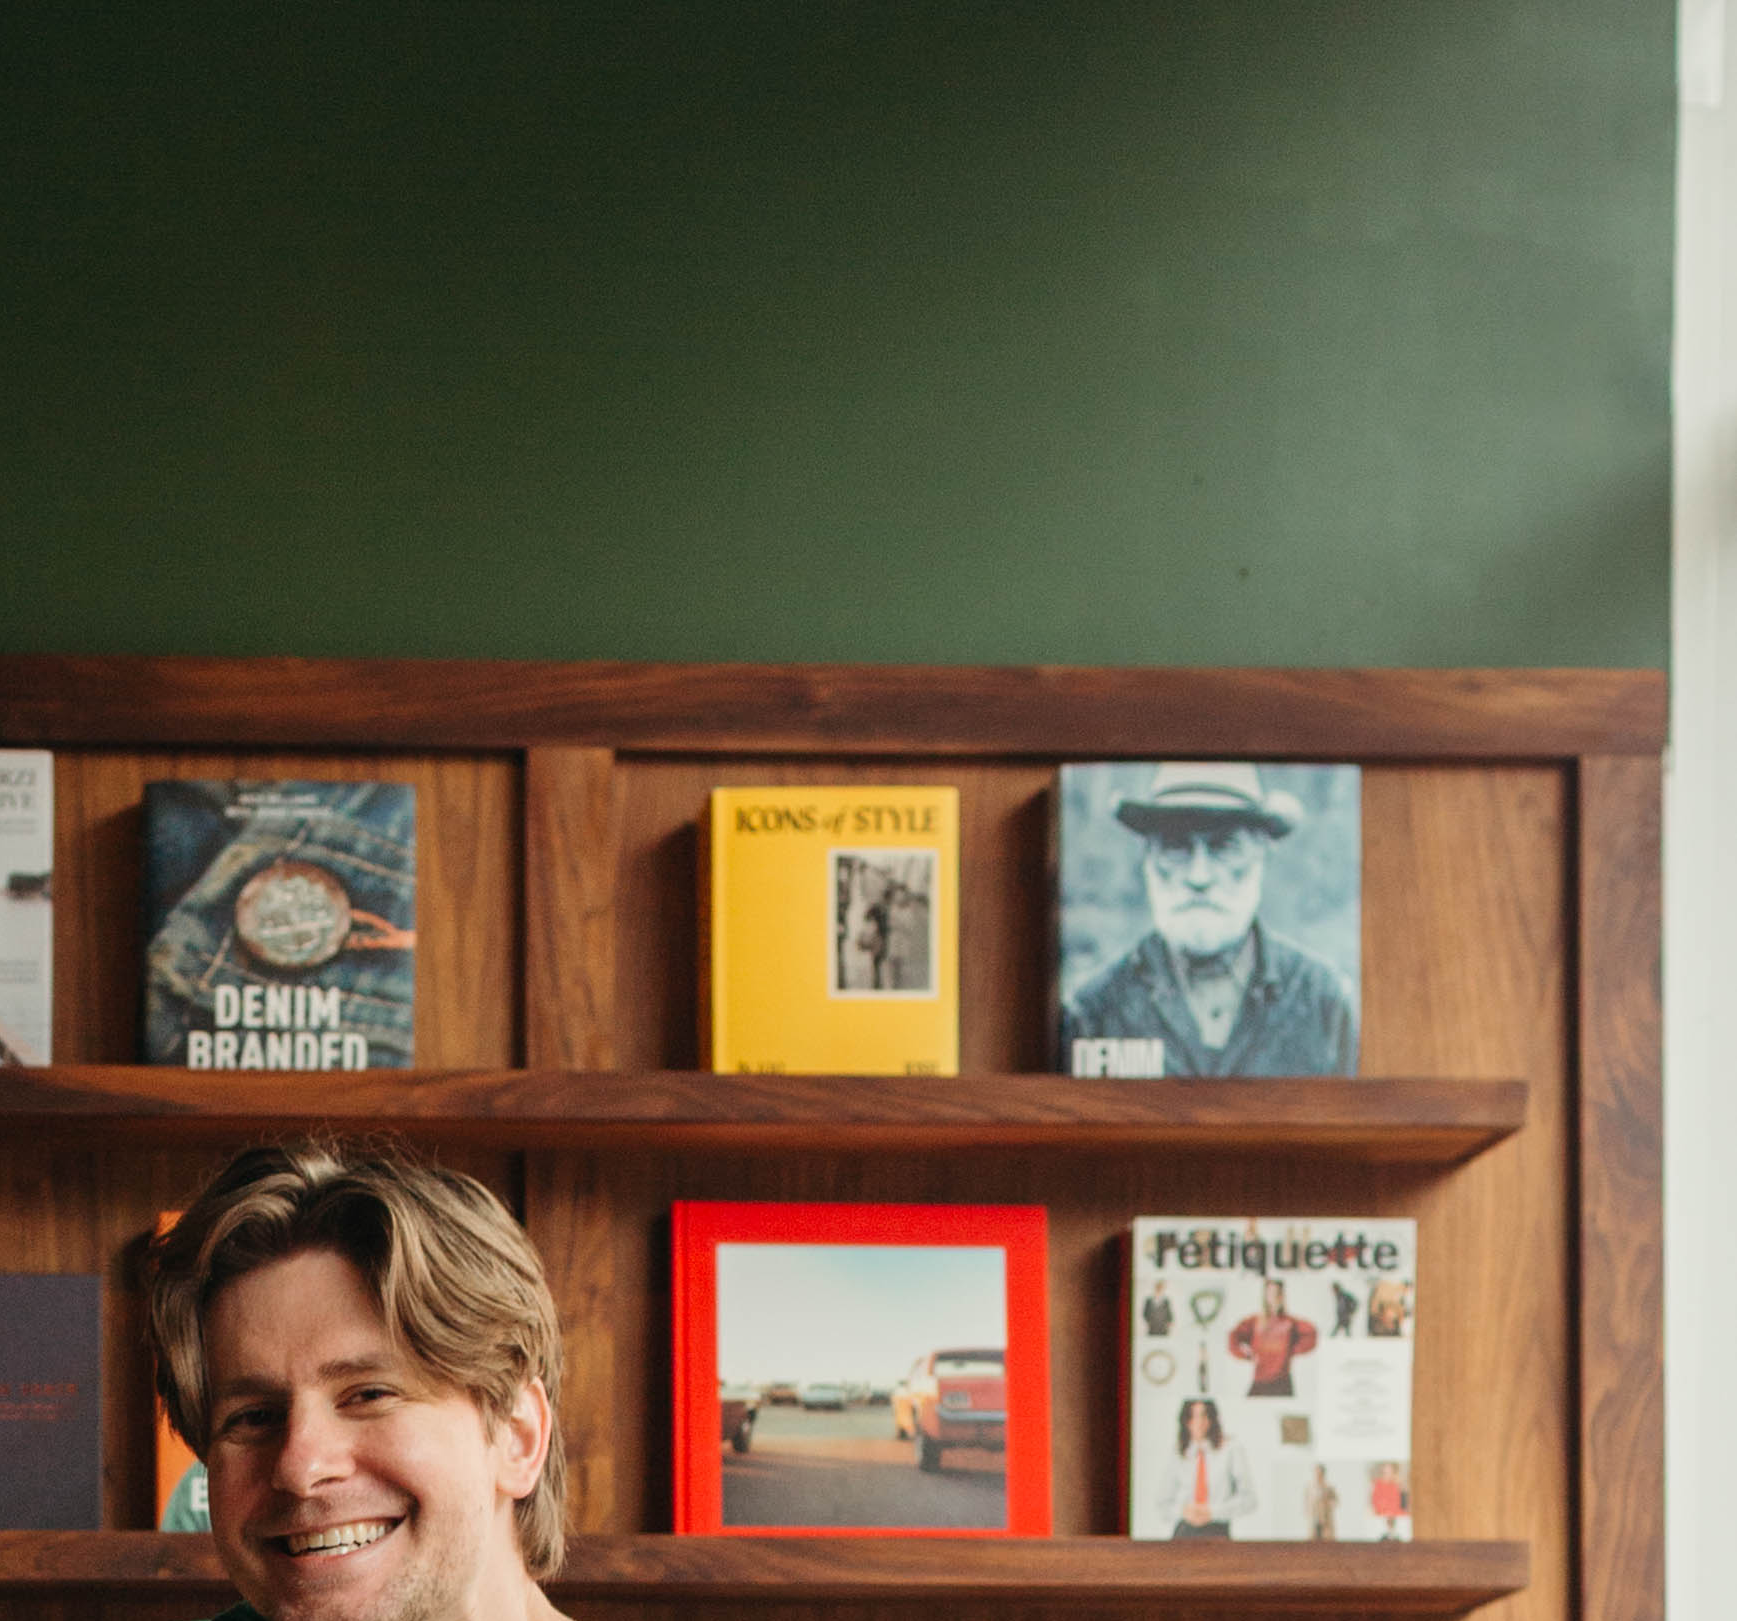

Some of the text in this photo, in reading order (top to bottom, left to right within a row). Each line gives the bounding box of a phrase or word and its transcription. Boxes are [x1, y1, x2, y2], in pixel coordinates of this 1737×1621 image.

[735, 805, 816, 833] ICONS
[853, 805, 935, 833] STYLE
[214, 984, 340, 1029] DENIM
